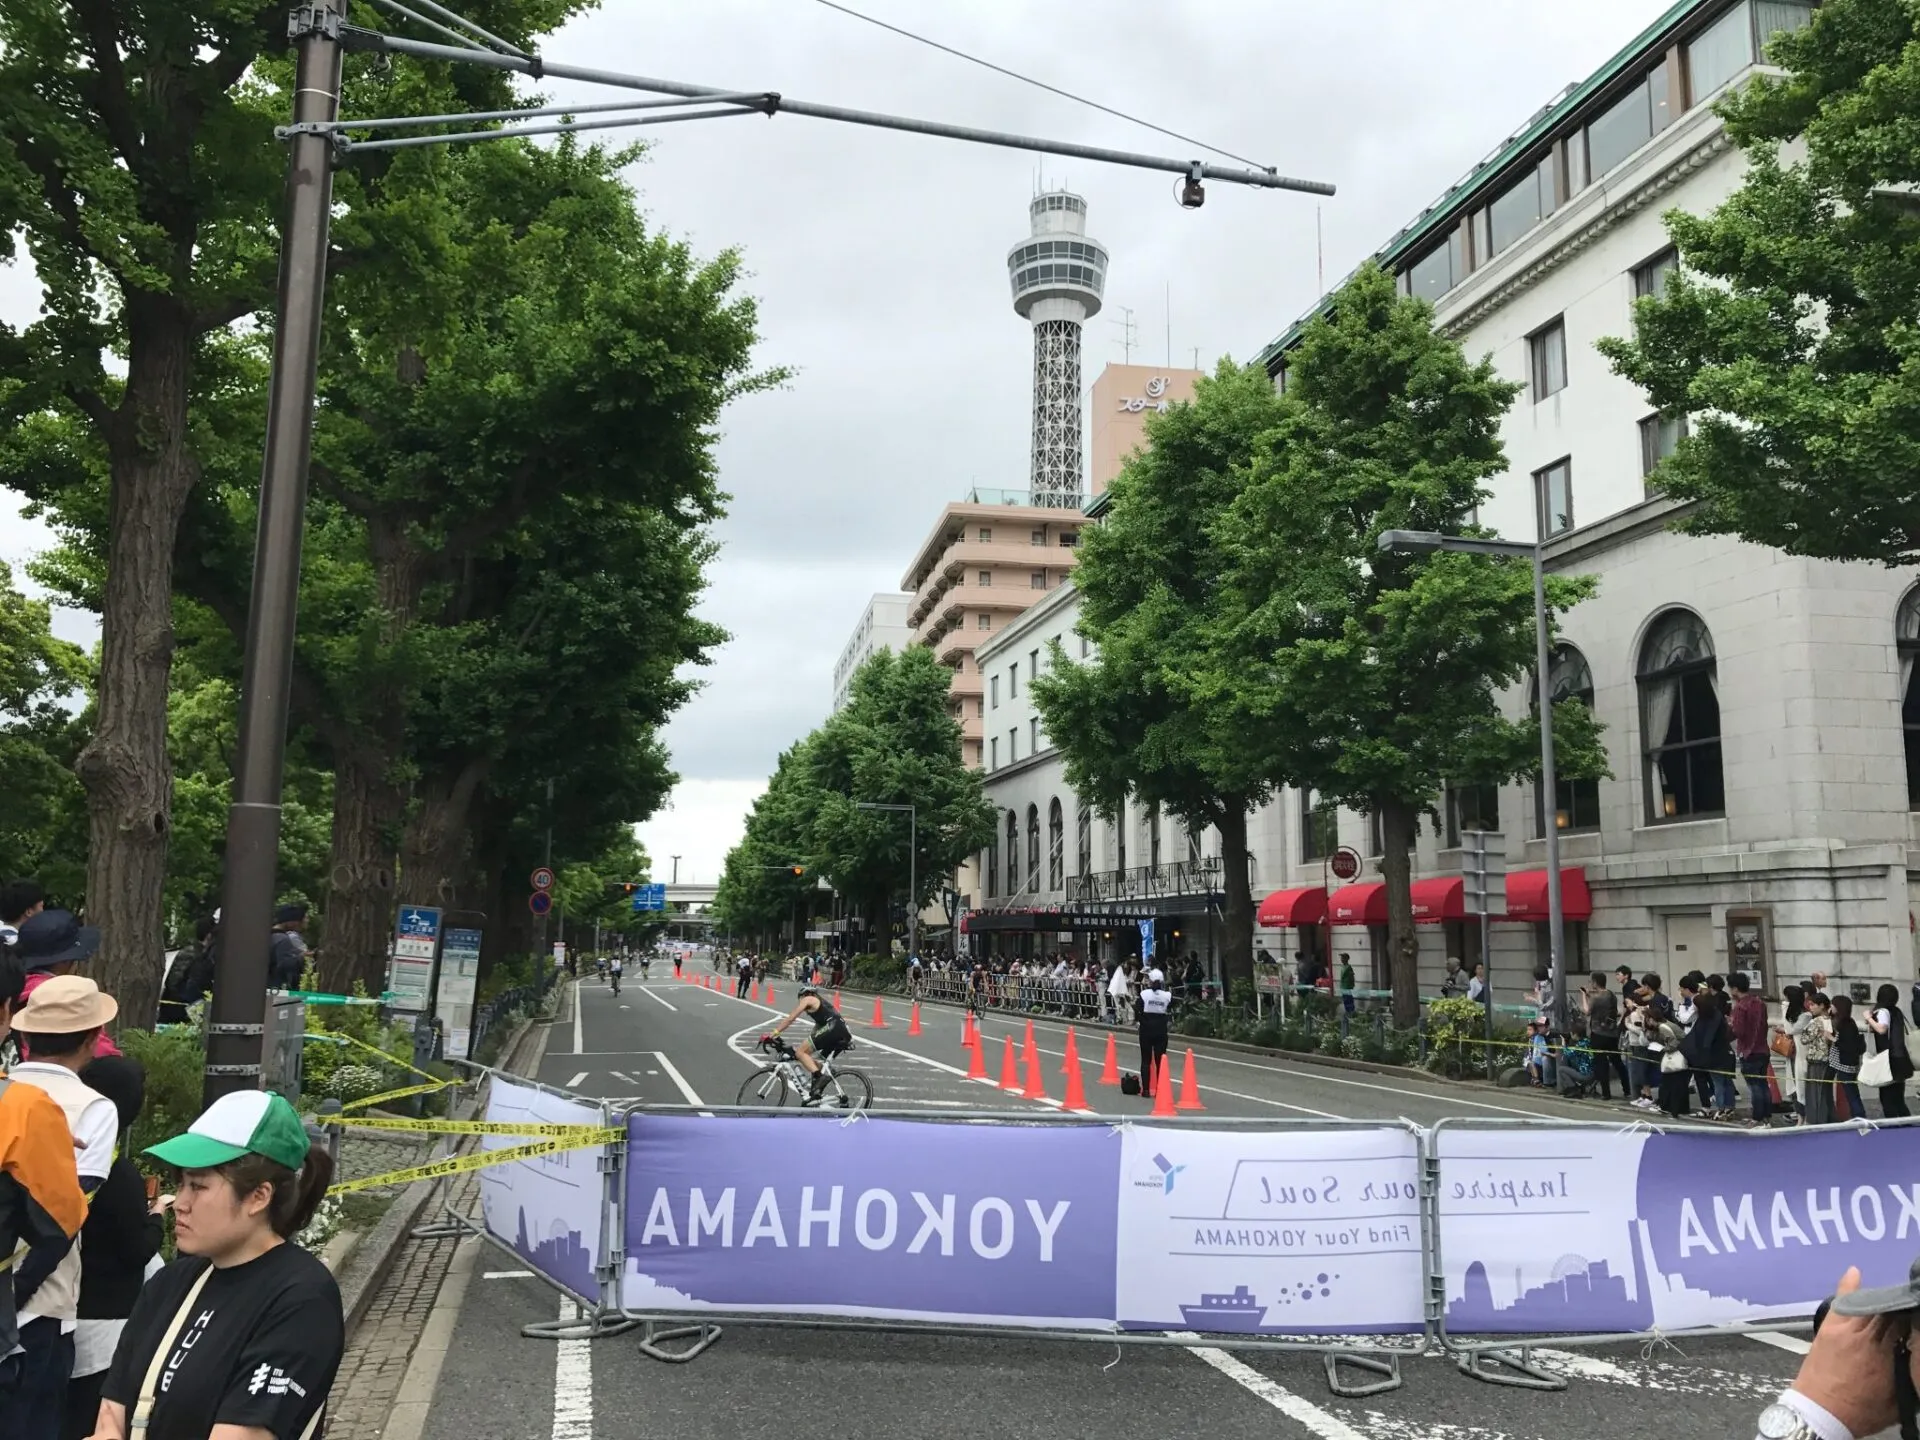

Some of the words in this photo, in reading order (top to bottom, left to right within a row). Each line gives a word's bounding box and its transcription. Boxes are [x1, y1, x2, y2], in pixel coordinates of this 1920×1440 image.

[536, 874, 549, 885] 40
[1084, 903, 1110, 915] NEW
[1116, 903, 1157, 915] GRAND
[517, 1142, 547, 1156] 立入禁止
[160, 1309, 215, 1392] HUUB
